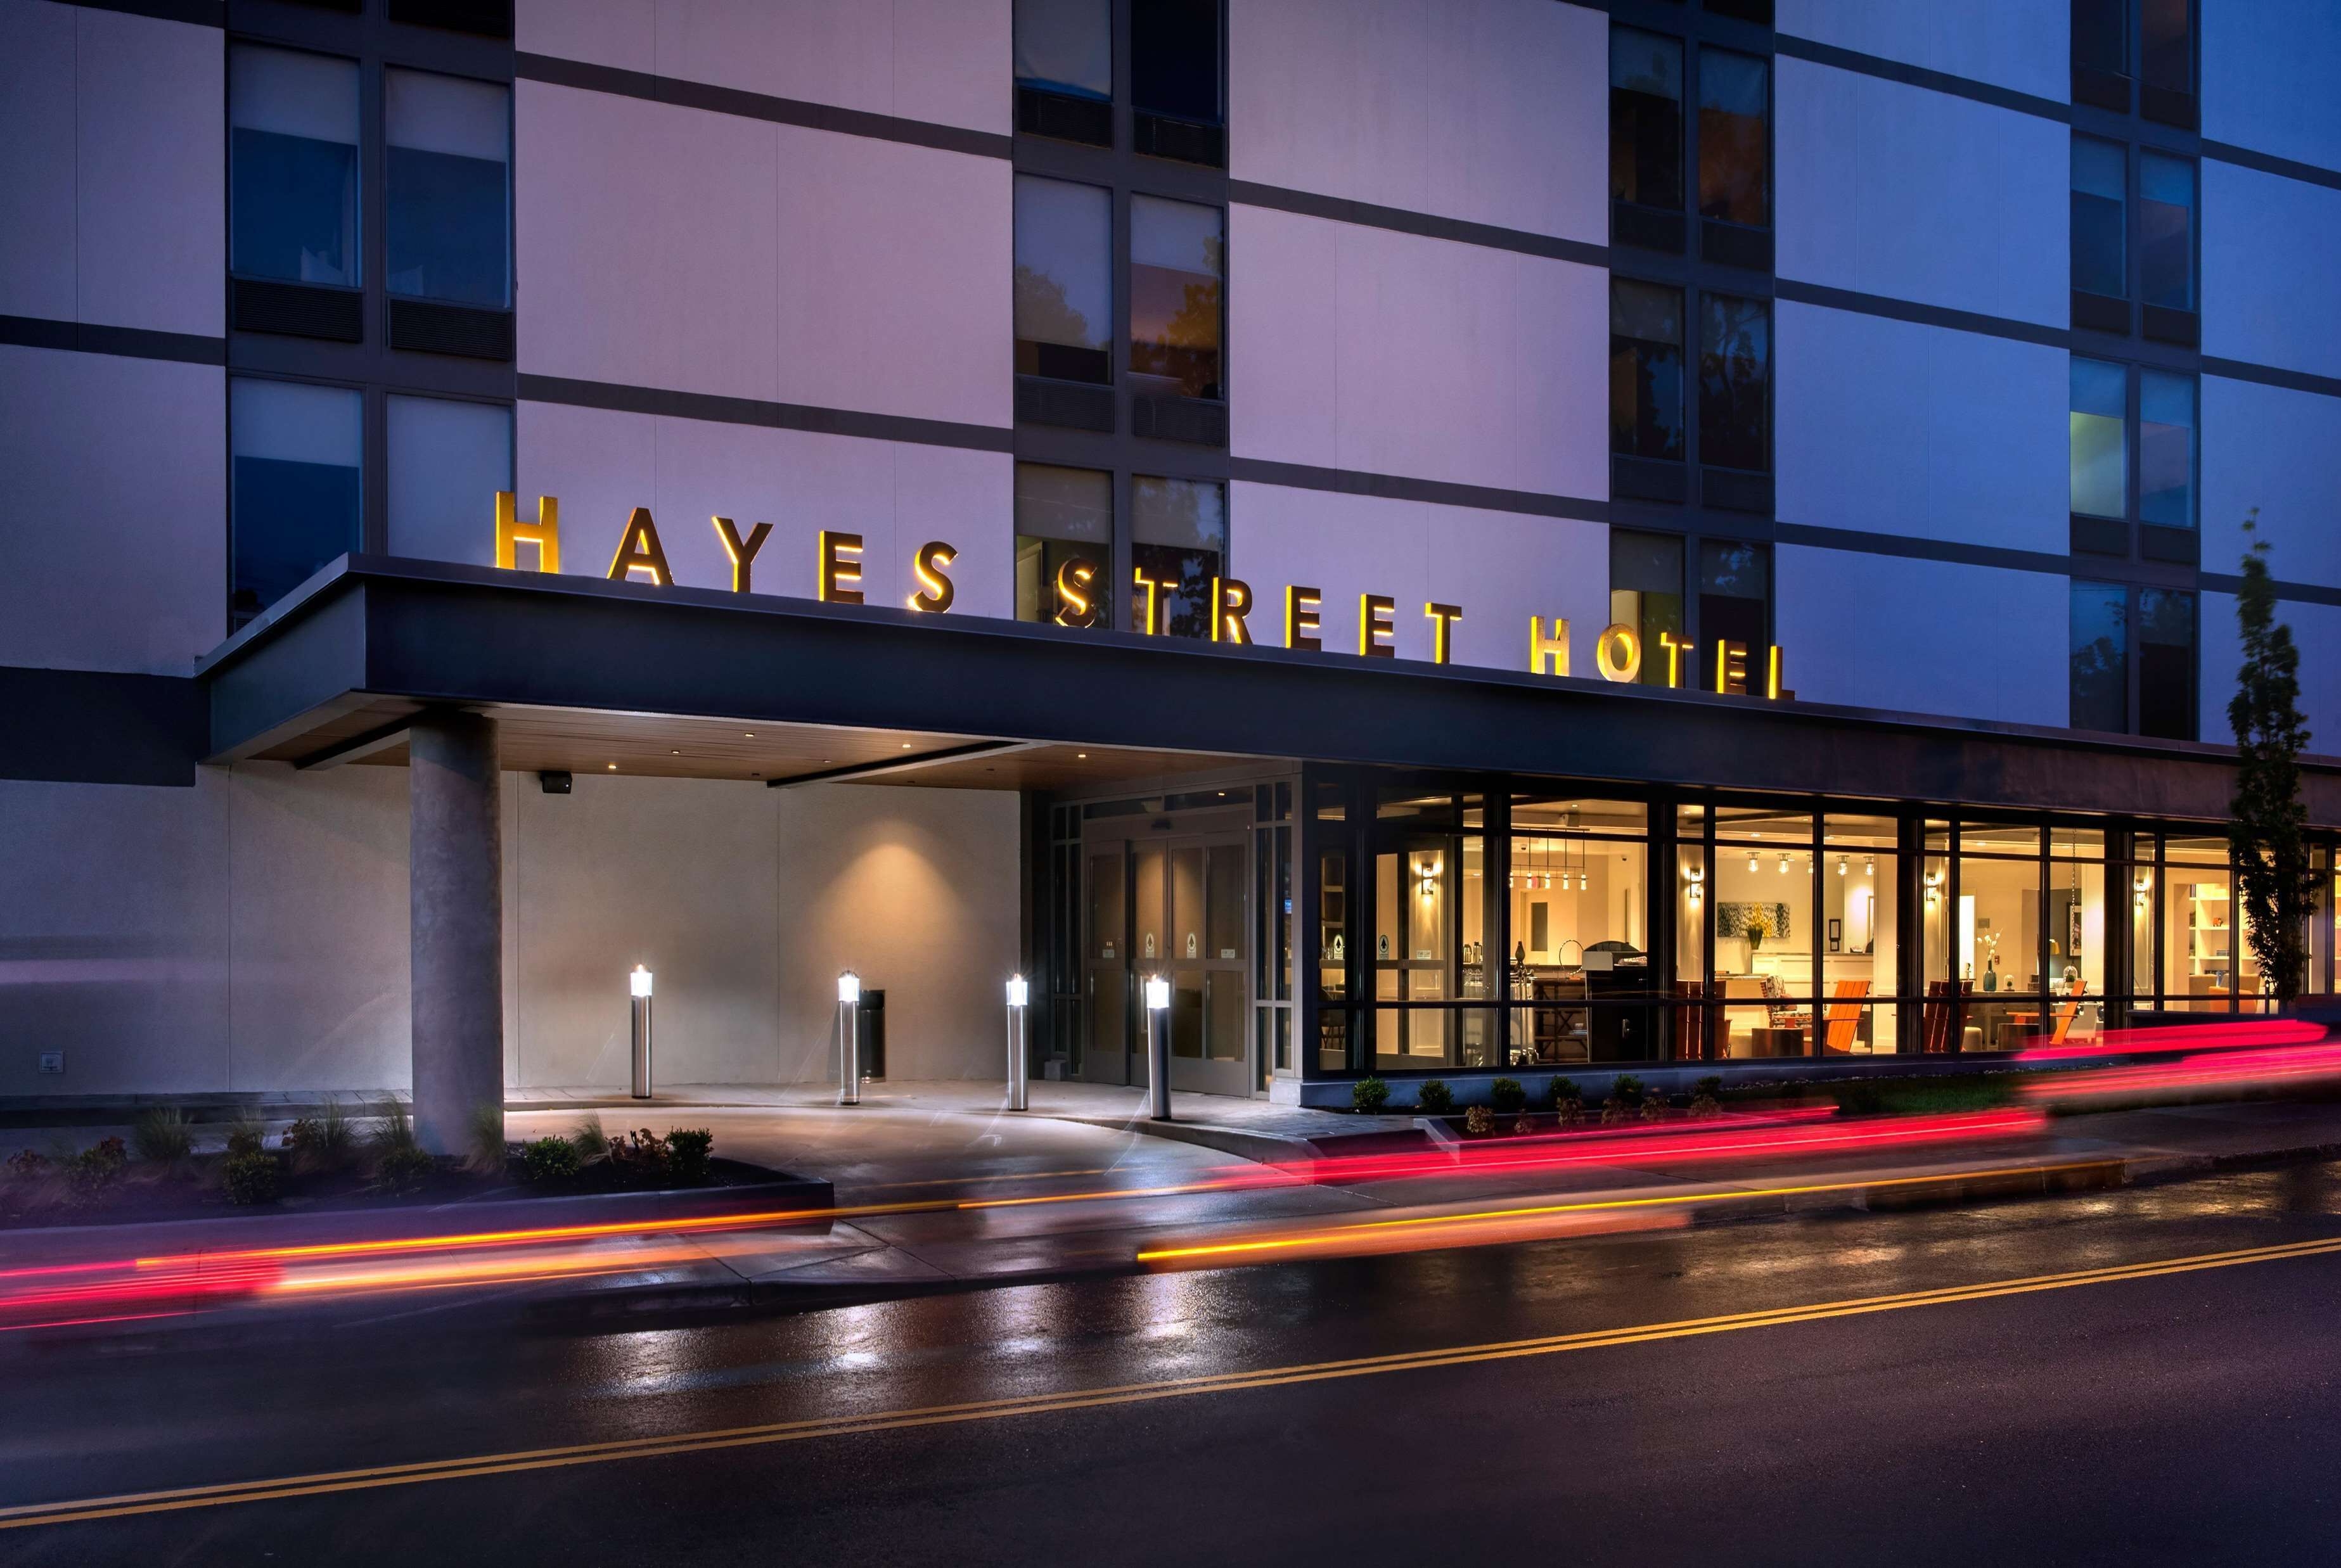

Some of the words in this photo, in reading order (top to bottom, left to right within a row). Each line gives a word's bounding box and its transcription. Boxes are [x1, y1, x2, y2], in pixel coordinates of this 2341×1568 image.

[495, 490, 959, 613] HAYES
[1055, 557, 1463, 664] STREET
[1530, 615, 1795, 701] HOTEL
